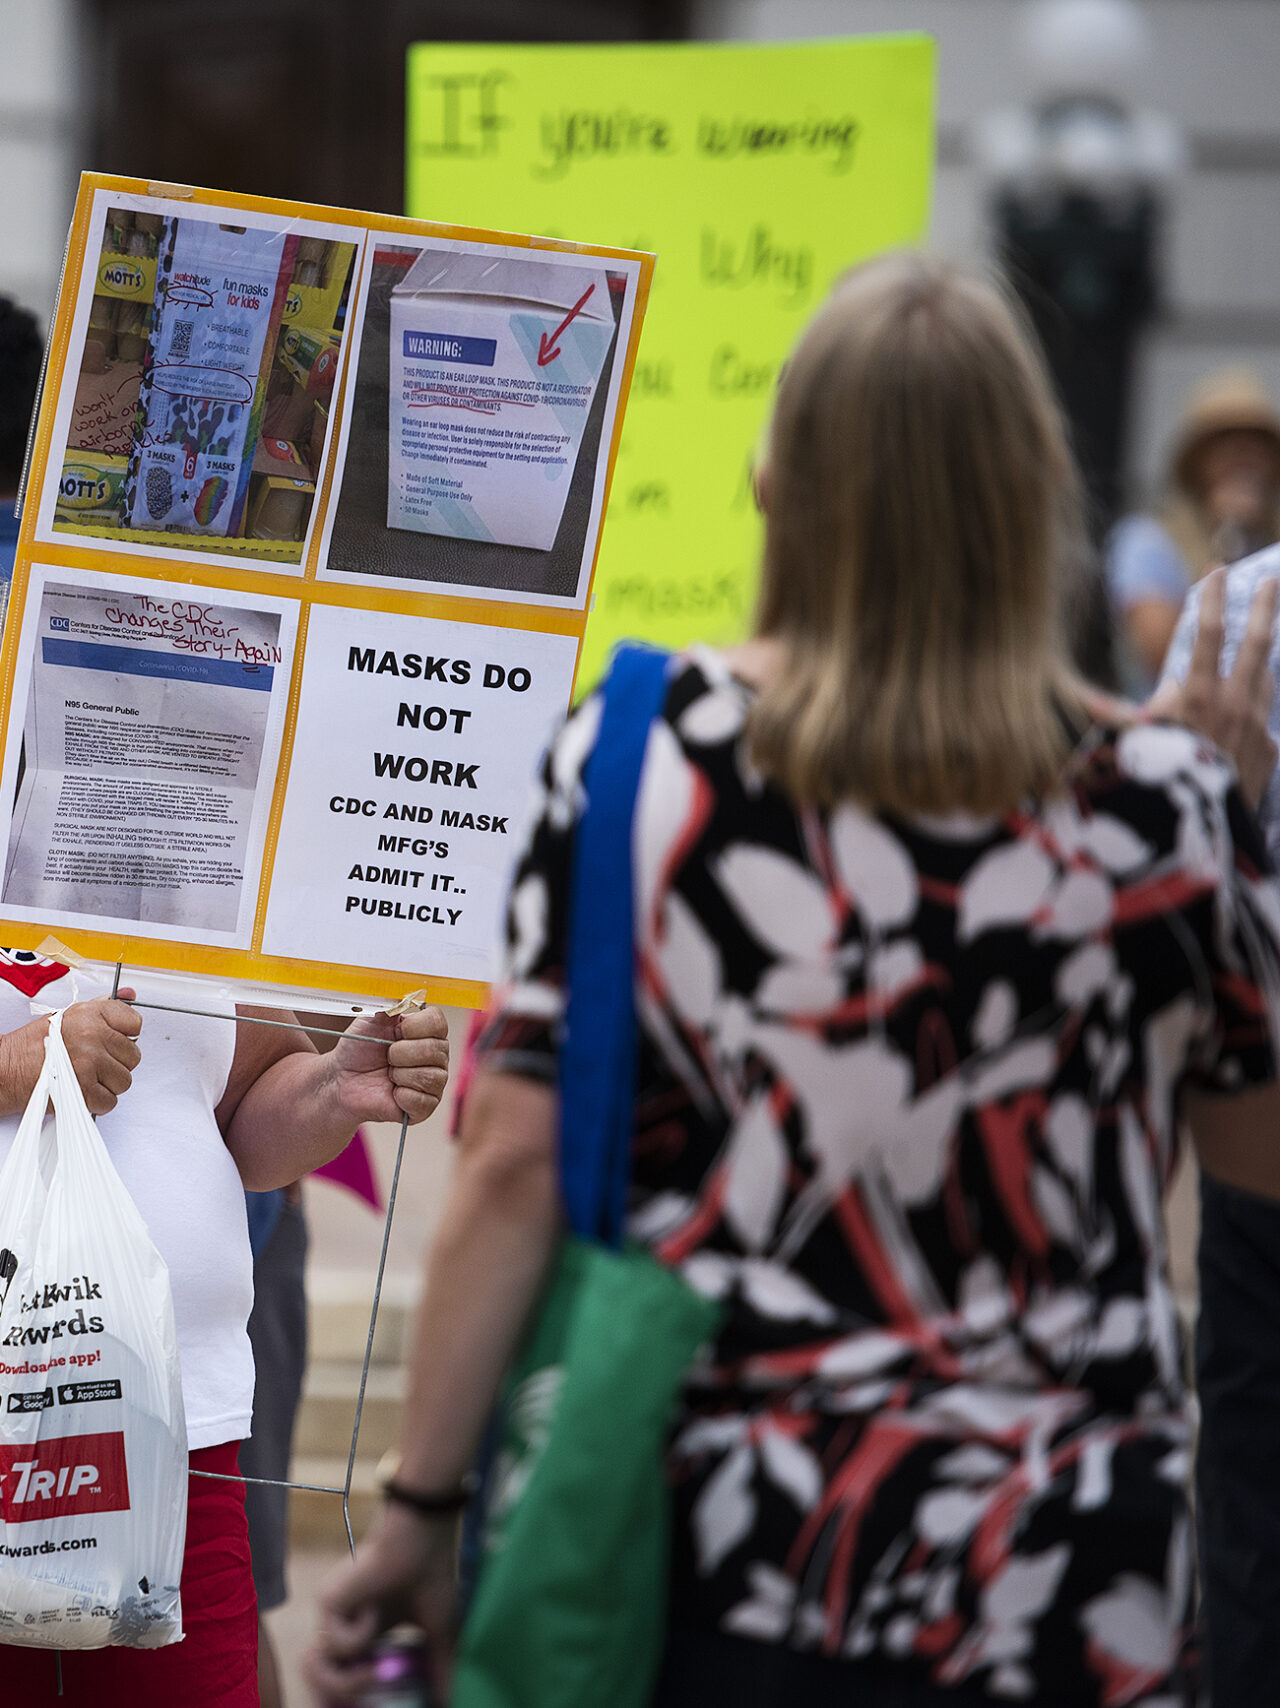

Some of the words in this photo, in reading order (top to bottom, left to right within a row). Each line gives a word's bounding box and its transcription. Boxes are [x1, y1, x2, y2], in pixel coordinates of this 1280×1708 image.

[222, 277, 238, 291] fun
[239, 281, 269, 298] masks
[226, 292, 240, 307] for
[241, 294, 260, 311] kids
[210, 323, 249, 338] BREATHABLE
[208, 341, 250, 356] COMFORTABLE
[408, 337, 462, 358] WARNING:
[204, 359, 222, 368] LIGHT
[402, 380, 412, 389] AND
[436, 383, 457, 393] PROVIDE
[458, 386, 468, 394] ANY
[469, 387, 499, 397] PROTECTION
[500, 390, 522, 400] AGAINST
[403, 367, 414, 377] THIS
[415, 368, 439, 379] PRODUCT
[440, 371, 445, 380] IS
[445, 371, 452, 380] AN
[454, 372, 464, 382] EAR
[464, 373, 478, 383] LOOP
[479, 375, 495, 385] MASK.
[497, 376, 508, 386] THIS
[510, 378, 535, 389] PRODUCT
[535, 380, 541, 389] IS
[541, 381, 553, 391] NOT
[553, 382, 557, 391] A
[558, 383, 591, 394] RESPIRATOR
[402, 392, 409, 400] OR
[450, 397, 457, 405] OR
[75, 410, 117, 432] work
[79, 418, 155, 448] airborne
[402, 417, 421, 429] Wearing
[438, 421, 449, 432] loop
[450, 422, 463, 431] mask
[464, 423, 476, 432] does
[477, 425, 486, 434] not
[486, 426, 504, 436] reduce
[504, 428, 513, 437] the
[514, 429, 523, 438] risk
[524, 430, 530, 438] of
[530, 430, 560, 444] contracting
[560, 435, 570, 445] any
[401, 428, 420, 438] disease
[427, 431, 449, 441] infection.
[450, 433, 462, 443] User
[468, 435, 482, 447] solely
[483, 437, 513, 451] responsible
[522, 441, 530, 450] the
[530, 442, 554, 453] selection
[555, 445, 561, 454] of
[146, 450, 152, 458] 3
[152, 451, 176, 463] MASKS
[401, 439, 427, 451] appropriate
[428, 442, 448, 454] personal
[448, 445, 471, 457] protective
[472, 448, 496, 460] equipment
[505, 451, 513, 459] the
[513, 452, 530, 463] setting
[531, 454, 540, 463] and
[540, 456, 567, 468] application.
[401, 449, 418, 461] Change
[420, 451, 448, 464] immediately
[449, 455, 453, 463] if
[453, 456, 487, 467] contaminated.
[185, 456, 194, 471] 6
[206, 461, 212, 470] 3
[212, 462, 235, 472] MASKS
[406, 472, 420, 482] Made
[421, 475, 427, 483] of
[428, 476, 439, 485] Soft
[440, 477, 463, 488] Material
[404, 497, 419, 505] Latex
[420, 499, 432, 507] Free
[405, 484, 425, 494] General
[427, 487, 448, 500] Purpose
[449, 490, 458, 499] Use
[460, 492, 472, 503] Only
[412, 508, 428, 516] Masks
[133, 595, 169, 614] The
[172, 602, 223, 625] CDC
[51, 618, 69, 630] CDC
[70, 621, 90, 630] Centers
[100, 624, 120, 634] Disease
[121, 627, 140, 636] Control
[184, 617, 239, 639] Their
[347, 646, 471, 684] MASKS
[482, 664, 531, 692] DO
[64, 700, 80, 709] N95
[82, 702, 113, 713] General
[115, 706, 139, 716] Public
[396, 702, 471, 734] NOT
[373, 752, 480, 789] WORK
[329, 796, 377, 817] CDC
[383, 803, 433, 824] AND
[440, 810, 509, 833] MASK
[105, 833, 136, 841] INHALING
[377, 835, 449, 858] MFG'S
[347, 864, 424, 888] ADMIT
[430, 875, 466, 894] IT..
[345, 896, 463, 925] PUBLICLY
[69, 1350, 102, 1367] app!
[77, 1390, 94, 1400] App
[95, 1388, 116, 1398] Store
[11, 1459, 99, 1504] TRIP
